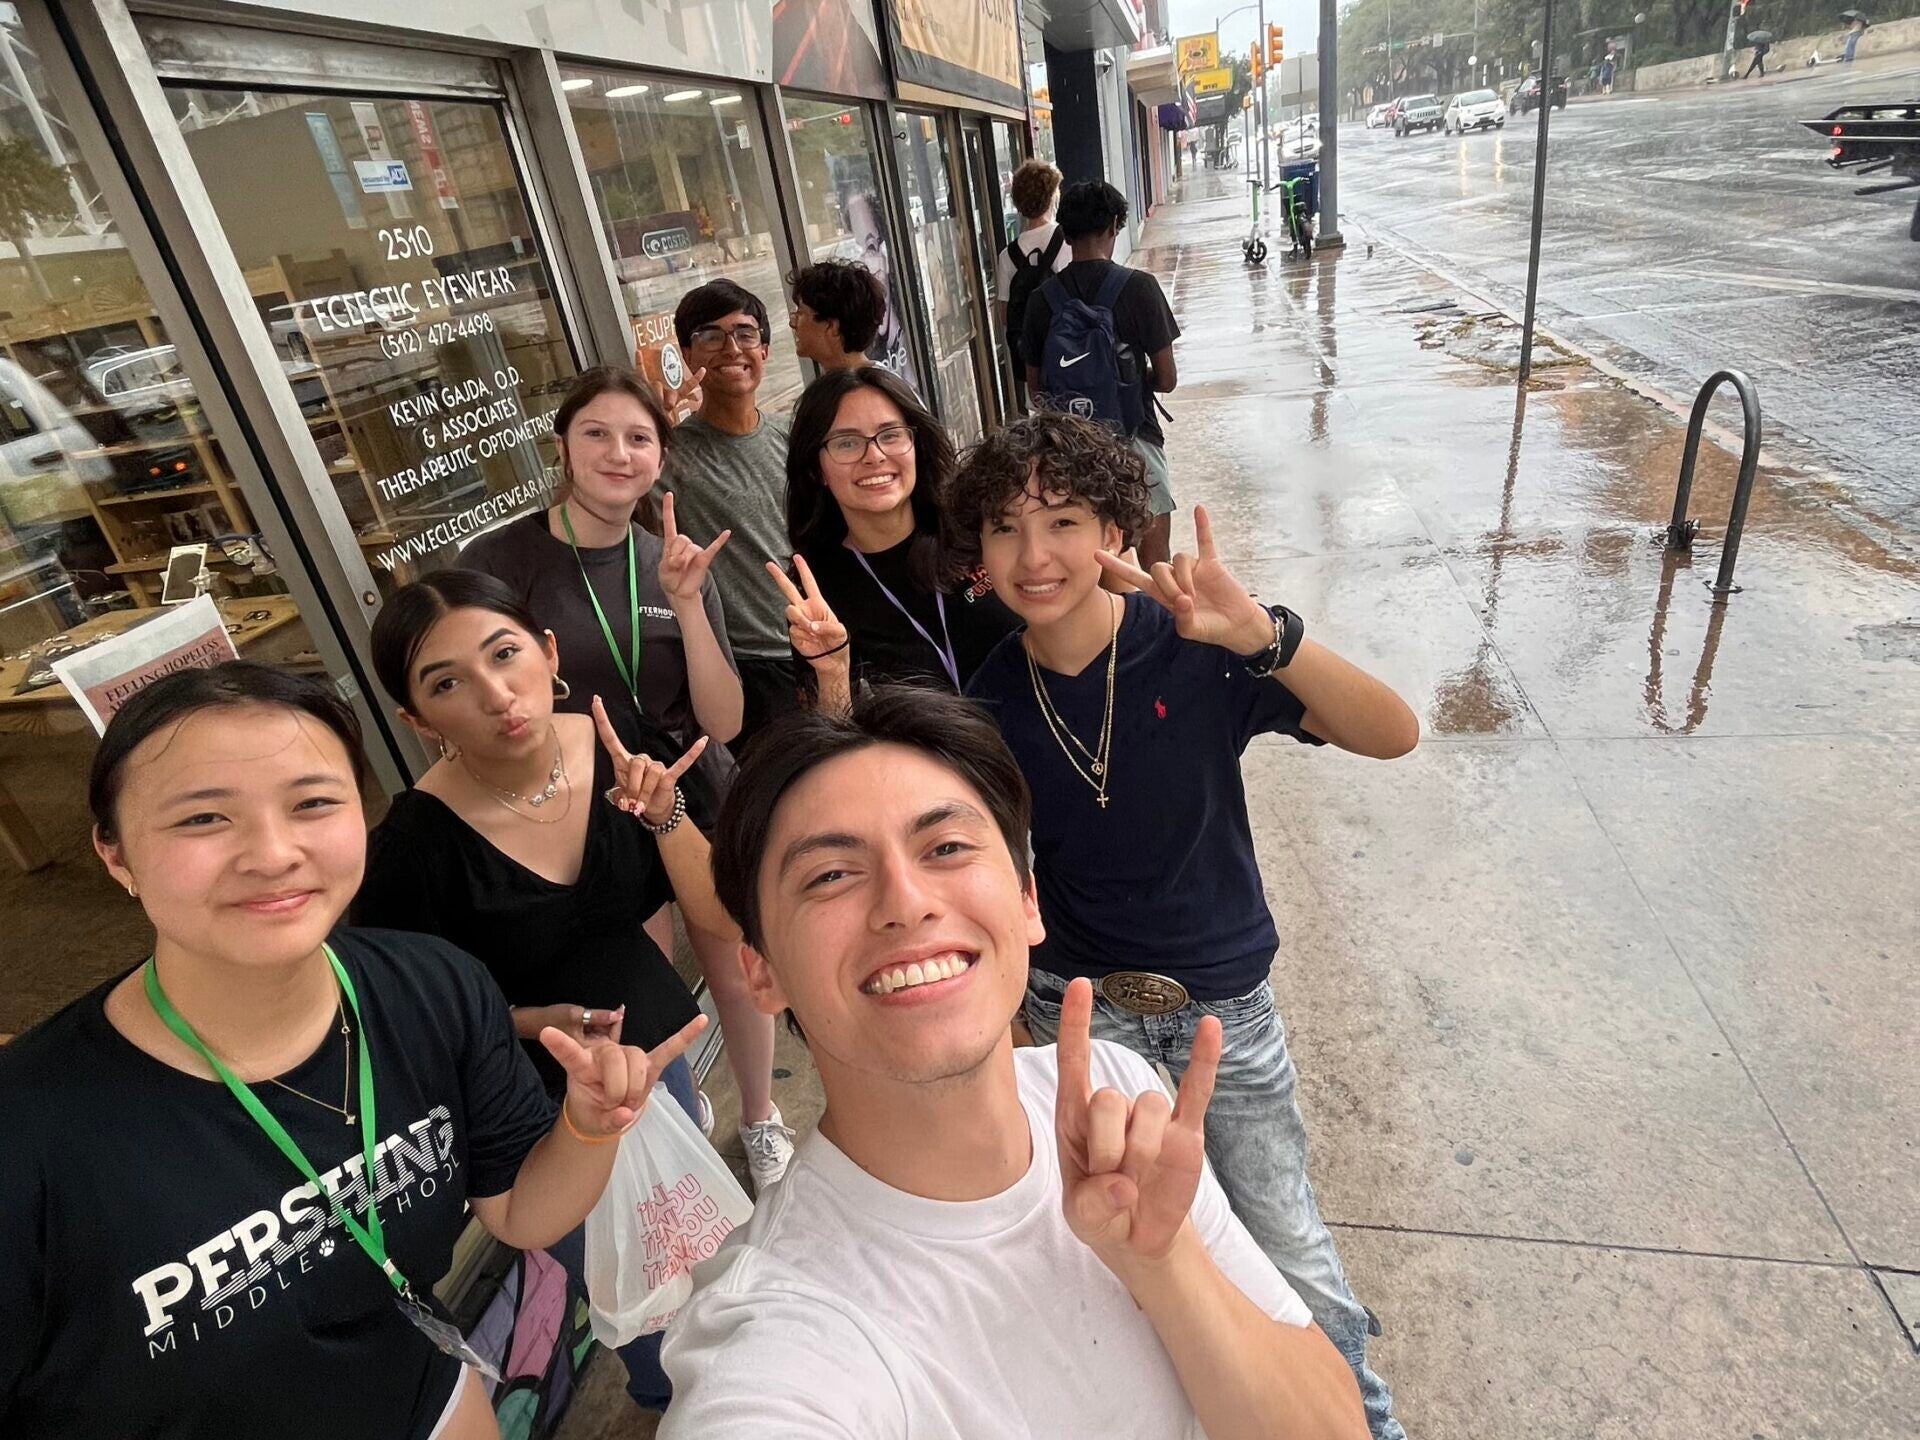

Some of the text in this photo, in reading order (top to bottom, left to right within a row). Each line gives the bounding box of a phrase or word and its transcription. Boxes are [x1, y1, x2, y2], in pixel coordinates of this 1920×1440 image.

[378, 225, 434, 261] 2510
[310, 266, 517, 332] ECLECTIC EYEWEAR
[379, 312, 494, 360] (512) 472-4498
[389, 366, 524, 427] KEVIN GAJDA, O.D.
[422, 397, 518, 449] & ASSOCIATES
[377, 408, 559, 502] THERAPEUTIC OPTOMETRIST
[637, 605, 676, 617] FTERHOU
[105, 639, 220, 703] FEELING HOPELESS
[149, 1250, 314, 1359] MIDDLE
